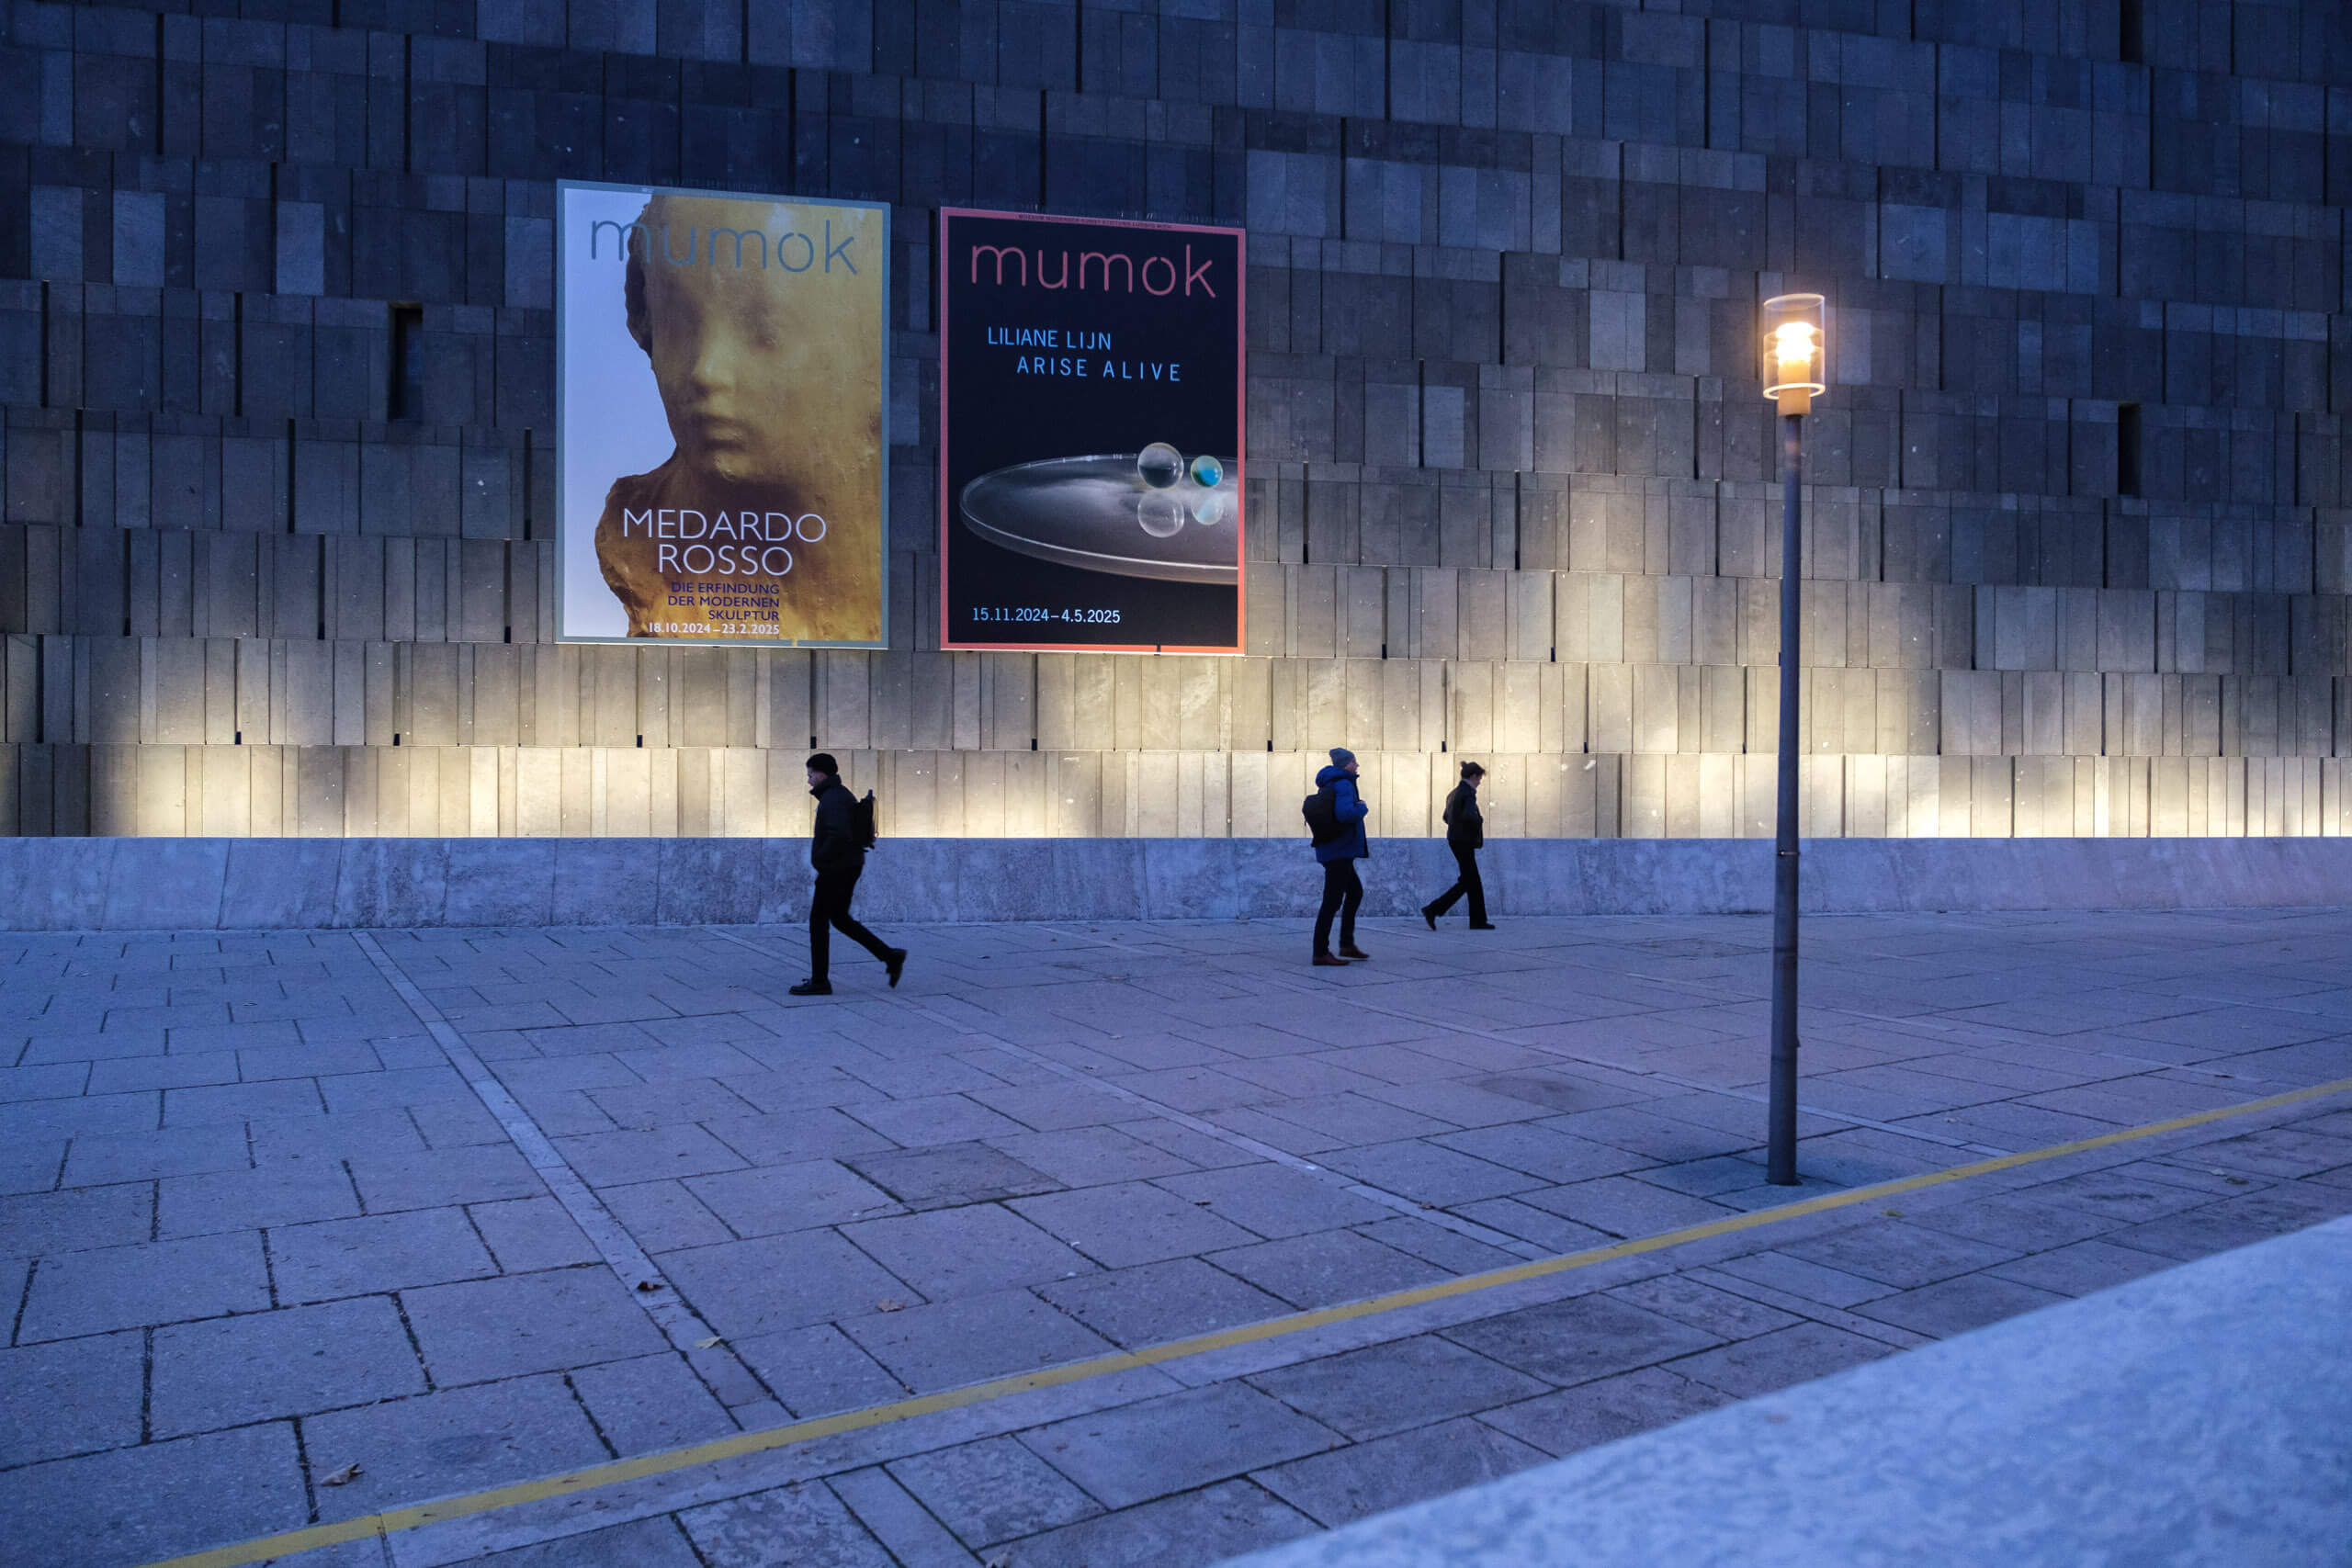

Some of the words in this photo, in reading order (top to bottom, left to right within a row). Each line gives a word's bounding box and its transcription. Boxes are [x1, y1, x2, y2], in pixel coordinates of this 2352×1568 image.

[591, 219, 858, 276] mumok
[971, 243, 1216, 299] mumok
[988, 326, 1058, 348] LILIANE
[1067, 330, 1112, 351] LIJN
[1016, 355, 1088, 378] ARISE
[1102, 359, 1181, 382] ALIVE
[623, 507, 827, 543] MEDARDO
[658, 544, 794, 576] ROSSO
[668, 595, 695, 606] DER
[699, 596, 780, 608] MODERNEN
[671, 581, 695, 593] DIE
[697, 582, 780, 595] ERFINDUNG
[707, 609, 780, 622] SKULPTUR
